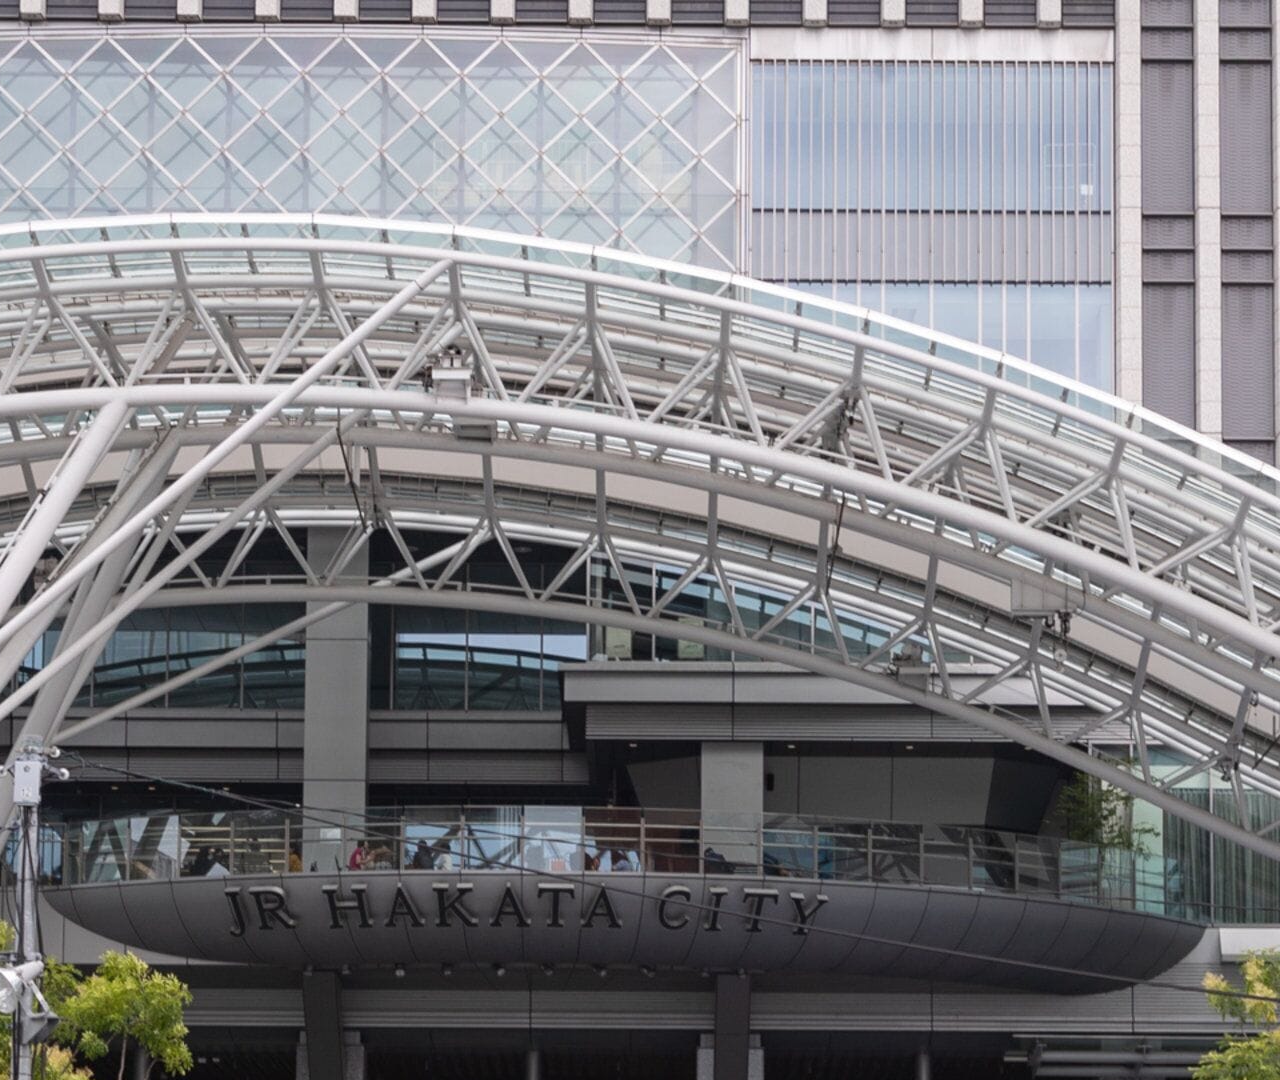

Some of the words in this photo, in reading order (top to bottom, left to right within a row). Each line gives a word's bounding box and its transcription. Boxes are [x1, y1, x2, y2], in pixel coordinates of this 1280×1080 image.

[224, 885, 297, 937] JR
[321, 881, 623, 930] HAKATA
[657, 884, 829, 938] CITY
